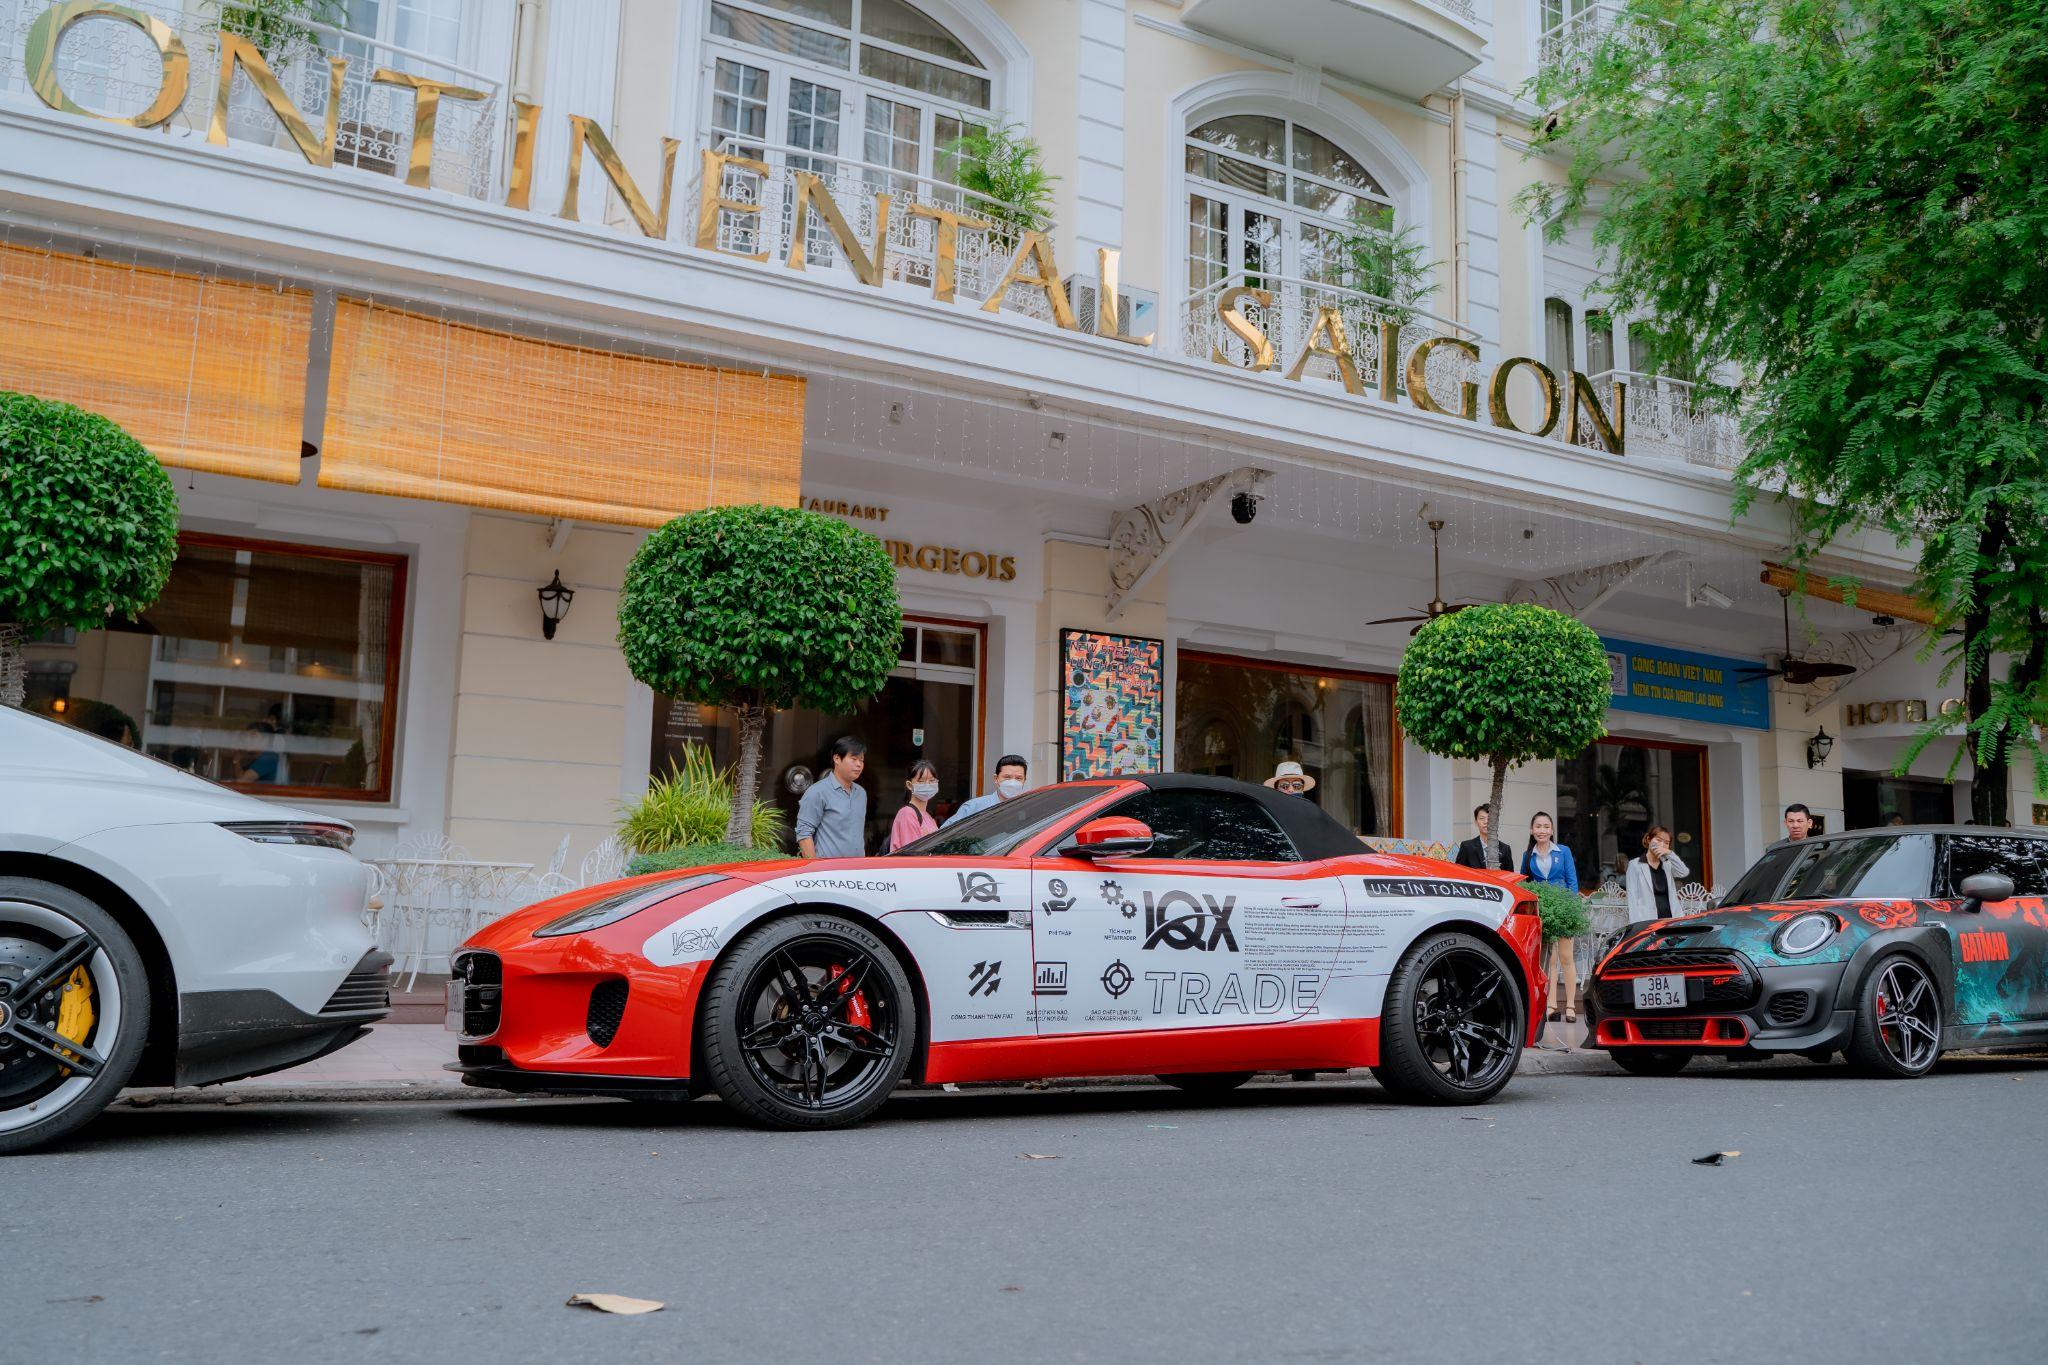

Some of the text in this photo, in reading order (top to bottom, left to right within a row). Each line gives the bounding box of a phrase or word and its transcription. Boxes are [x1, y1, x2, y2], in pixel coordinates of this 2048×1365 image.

[1211, 286, 1626, 457] SAIGON
[1071, 641, 1098, 653] NEW
[1070, 658, 1108, 671] LUNCH
[1702, 668, 1723, 684] NAM
[795, 879, 897, 892] IQXTRADE.COM
[1370, 883, 1395, 895] UY
[1398, 881, 1426, 895] TÍN
[1429, 883, 1471, 897] TOÀN
[1142, 890, 1240, 952] IQX
[820, 921, 879, 950] MICHELIN
[1959, 927, 2010, 963] BATMAN
[1647, 977, 1670, 991] 38A
[1144, 971, 1320, 1015] TRADE
[1640, 992, 1680, 1006] 386.34
